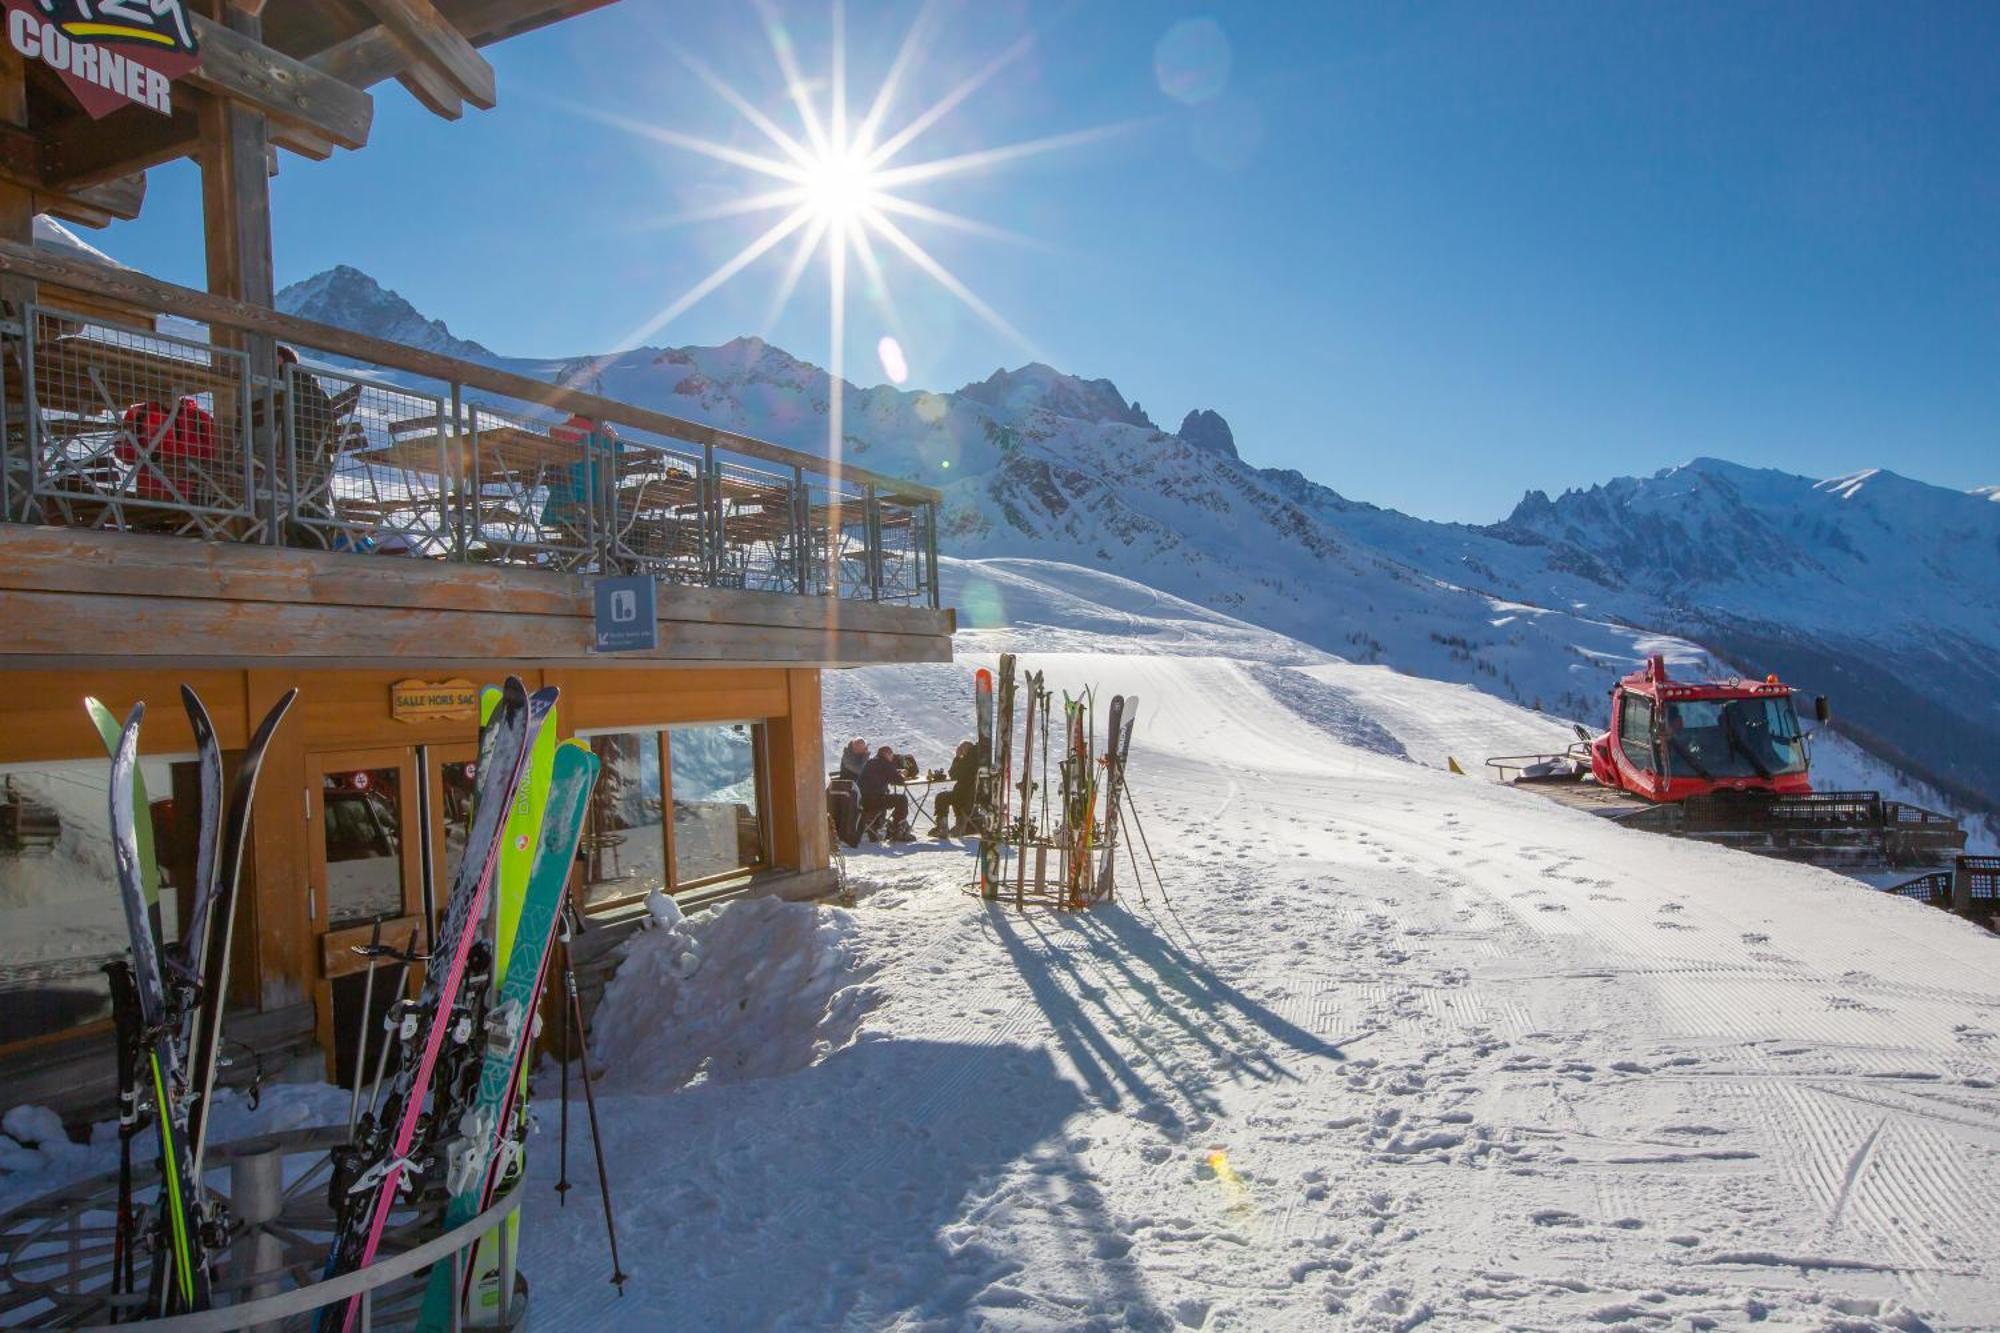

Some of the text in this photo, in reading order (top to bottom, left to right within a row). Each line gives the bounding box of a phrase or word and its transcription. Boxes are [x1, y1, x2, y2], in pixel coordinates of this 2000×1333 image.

[10, 9, 172, 117] CORNER
[397, 693, 474, 706] SALLE HORS SAC
[518, 760, 534, 814] DYNA
